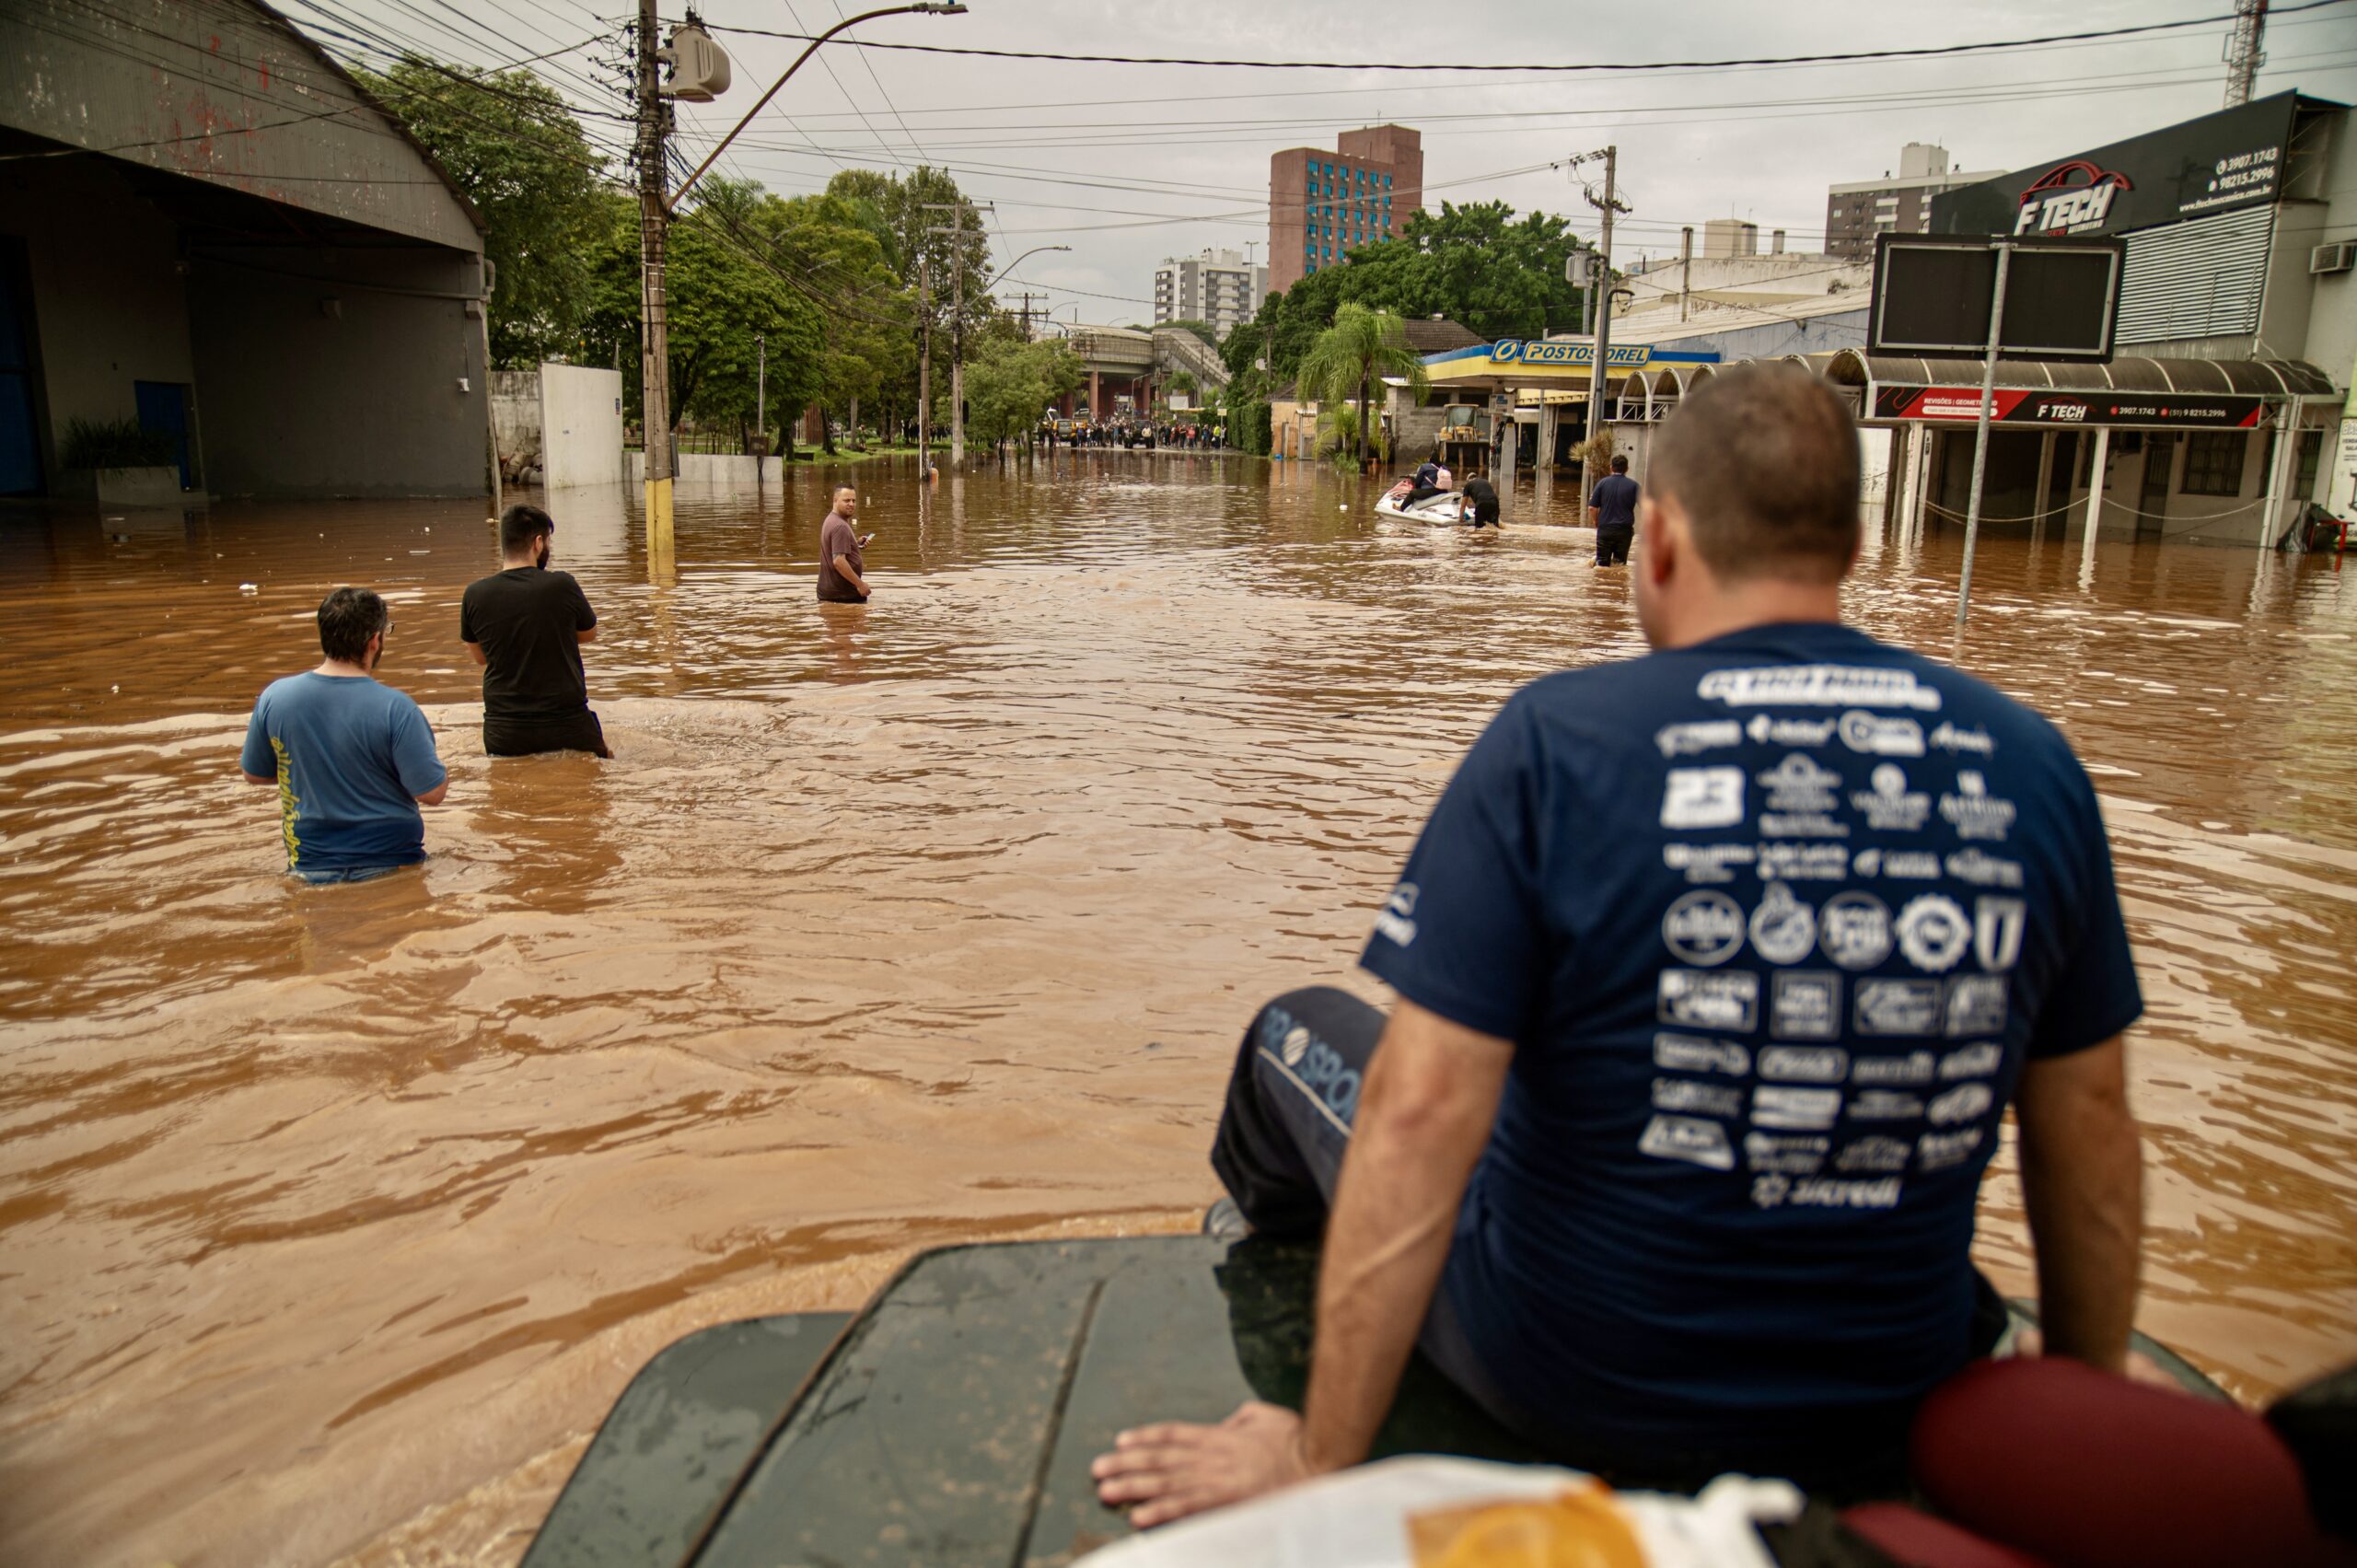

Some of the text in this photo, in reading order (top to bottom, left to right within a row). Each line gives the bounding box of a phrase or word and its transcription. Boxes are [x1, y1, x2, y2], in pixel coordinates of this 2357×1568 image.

[2228, 147, 2279, 171] 3907.1743
[2220, 167, 2275, 190] 98215.2996
[2014, 183, 2116, 236] F TECH
[2038, 405, 2087, 418] F TECH
[2119, 407, 2155, 415] 3907.1743
[2189, 409, 2225, 417] 8215.2996
